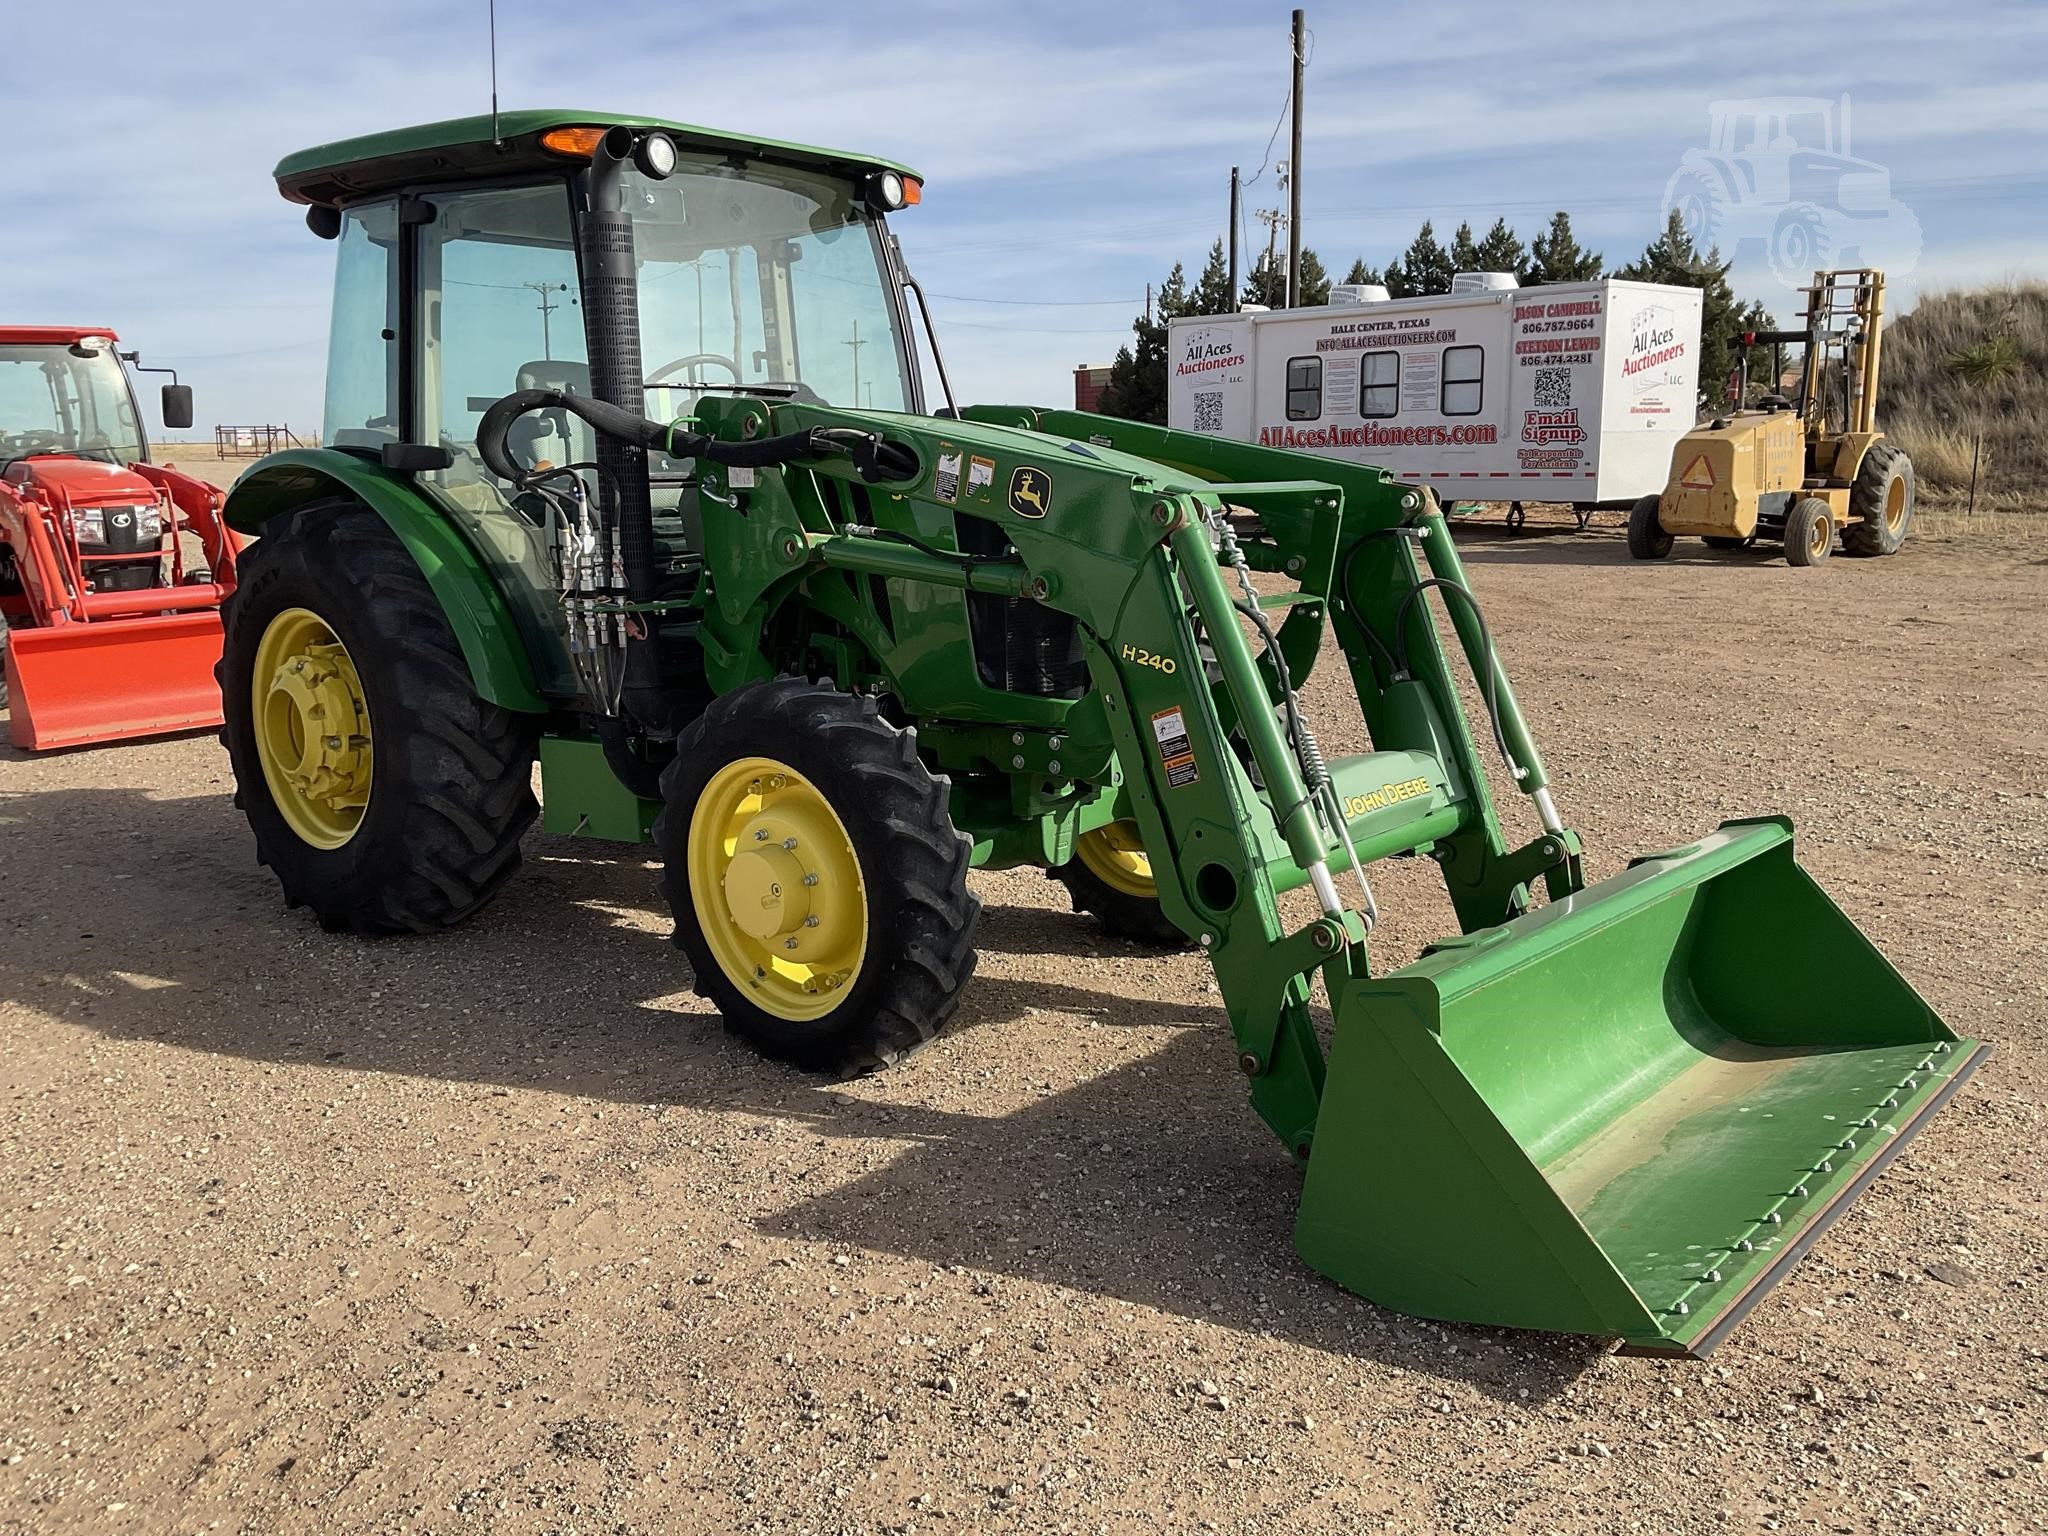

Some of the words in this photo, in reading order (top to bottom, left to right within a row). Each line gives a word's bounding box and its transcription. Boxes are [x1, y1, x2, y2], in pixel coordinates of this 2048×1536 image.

[1513, 305, 1546, 324] JASON
[1547, 300, 1603, 318] CAMPBELL
[1331, 324, 1355, 335] HALE
[1357, 321, 1396, 333] CENTER,
[1399, 318, 1430, 329] TEXAS
[1522, 318, 1595, 334] 806.787.9664
[1515, 338, 1563, 355] STETSON
[1563, 336, 1601, 353] LEWIS
[1632, 331, 1648, 355] All
[1649, 328, 1674, 349] Aces
[1186, 345, 1203, 361] All
[1204, 343, 1233, 358] Aces
[1521, 353, 1593, 367] 806.474.2281
[1621, 343, 1685, 378] Auctioneers
[1175, 354, 1245, 377] Auctioneers
[1526, 409, 1577, 426] Email
[1259, 421, 1498, 448] AllAcesAuctioneers.com
[1523, 427, 1587, 444] Signup.
[1518, 449, 1533, 459] Not
[1533, 448, 1583, 459] Responsible
[1521, 460, 1537, 469] For
[1537, 459, 1578, 469] Accidents
[1122, 644, 1176, 675] H240
[1344, 790, 1388, 819] JOHN
[1382, 777, 1431, 805] DEERE
